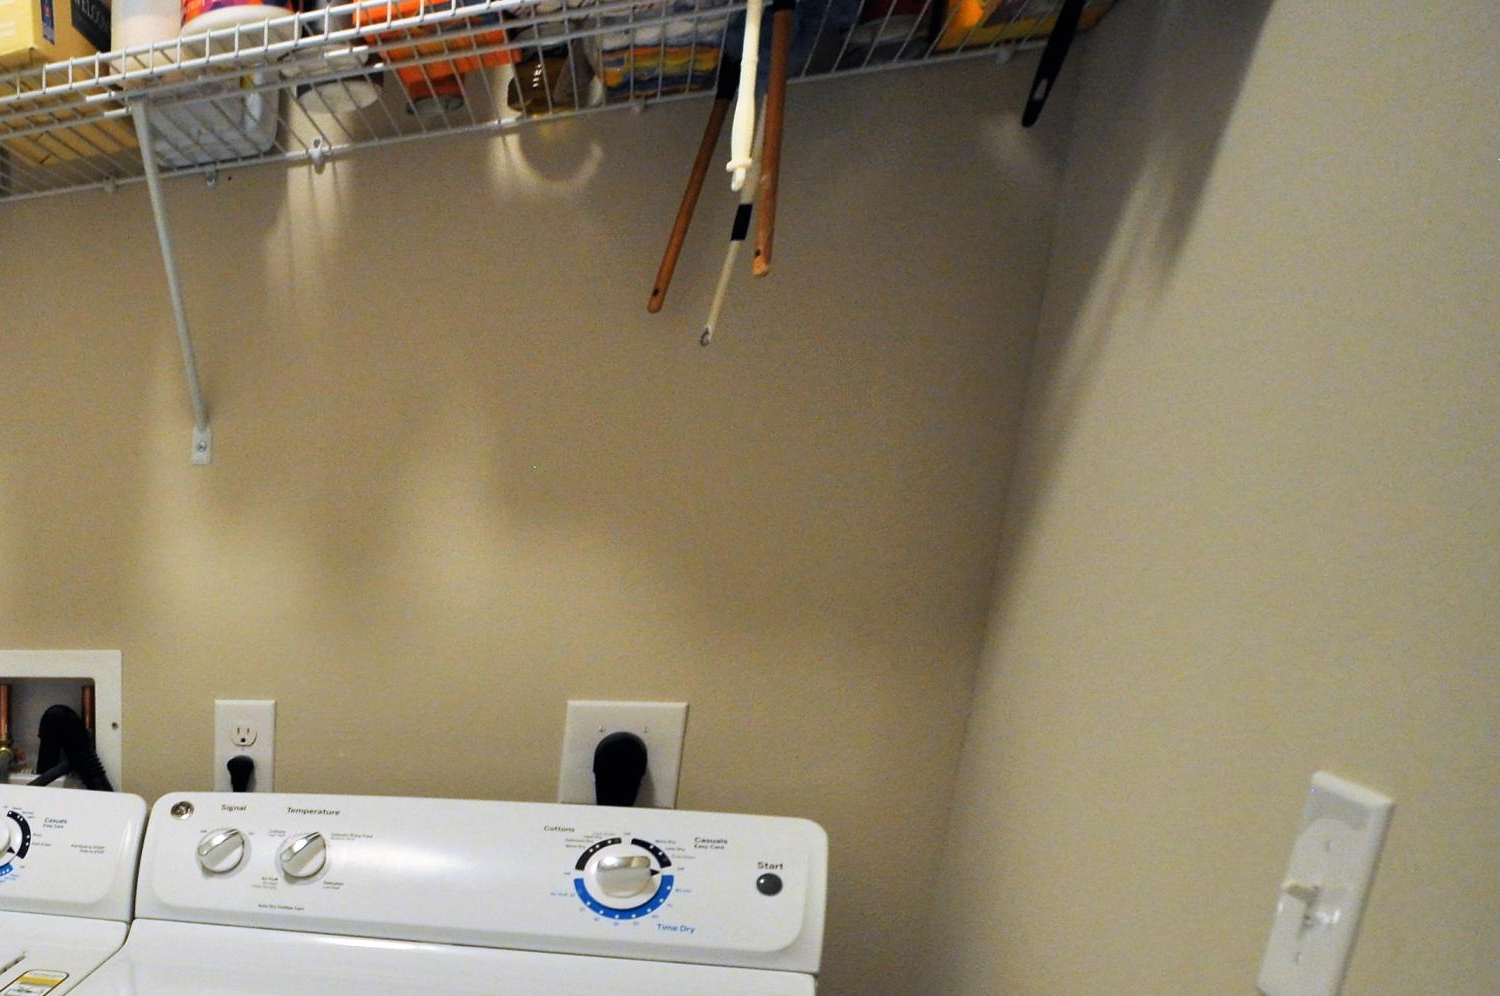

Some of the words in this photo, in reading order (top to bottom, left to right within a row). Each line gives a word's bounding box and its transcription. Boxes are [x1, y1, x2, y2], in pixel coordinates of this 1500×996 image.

[220, 803, 248, 813] Signal
[286, 806, 341, 817] Temperature
[757, 861, 784, 870] Start
[657, 923, 678, 932] Time
[679, 924, 696, 935] Dry
